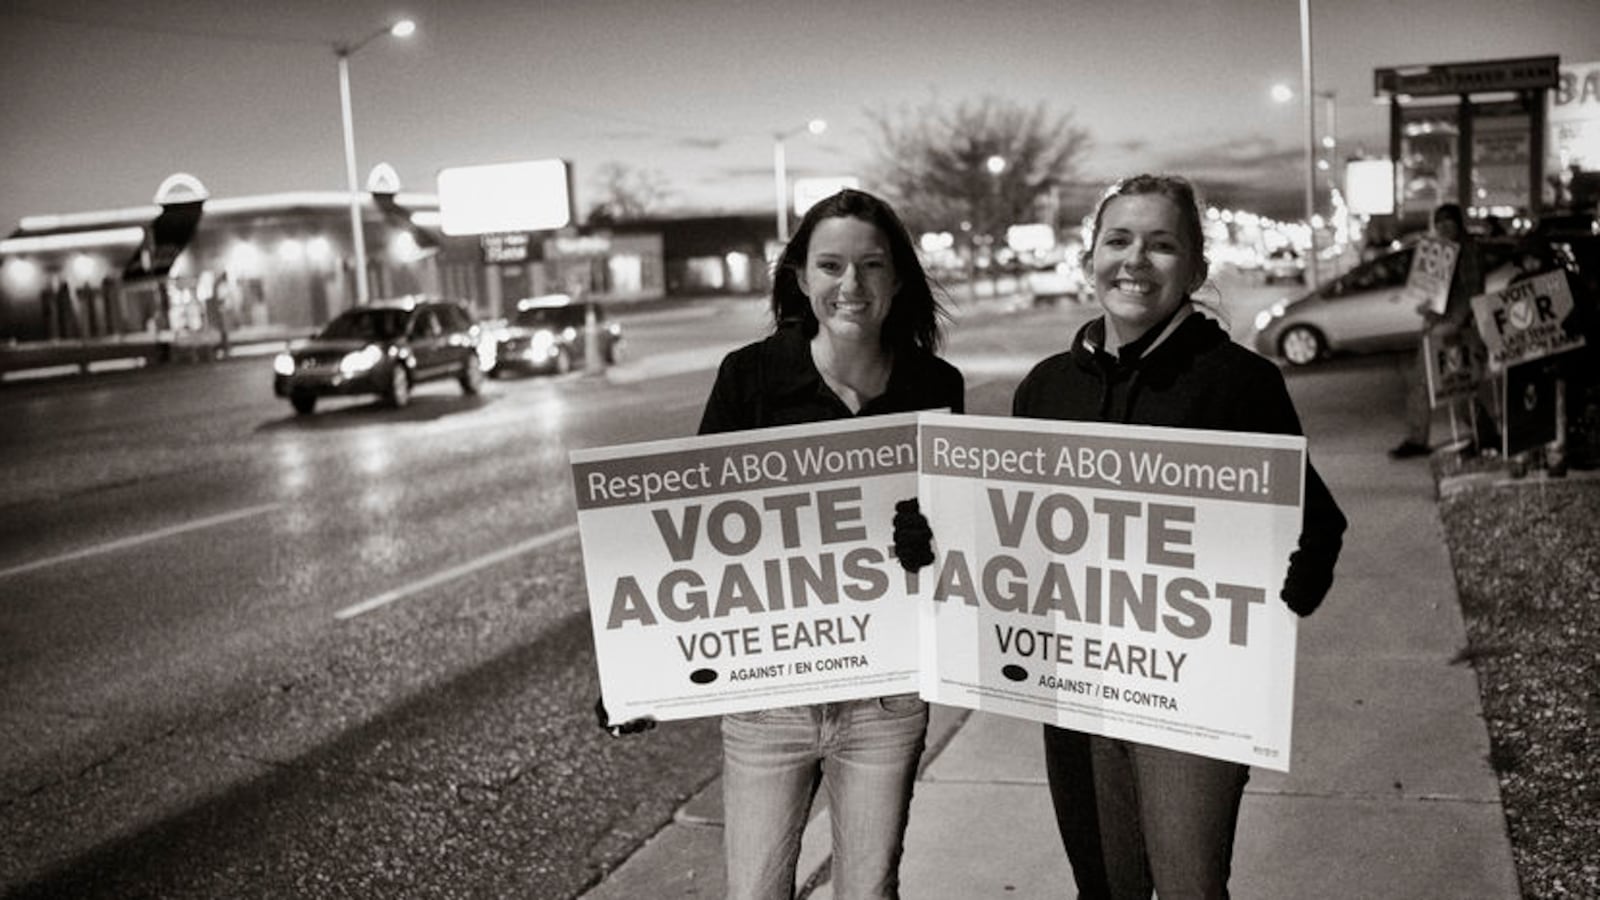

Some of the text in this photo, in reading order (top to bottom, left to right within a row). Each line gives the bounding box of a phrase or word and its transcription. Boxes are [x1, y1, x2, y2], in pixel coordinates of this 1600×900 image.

[588, 462, 711, 501] Respect
[720, 452, 788, 487] ABQ
[933, 437, 1271, 494] Respect ABQ Women!
[651, 486, 867, 562] VOTE
[987, 488, 1196, 569] VOTE
[933, 549, 1266, 647] AGAINST
[676, 613, 872, 662] VOTE EARLY
[995, 624, 1188, 683] VOTE EARLY
[729, 664, 785, 682] AGAINST
[795, 661, 813, 675] EN
[816, 654, 868, 673] CONTRA
[1038, 674, 1093, 697] AGAINST
[1102, 685, 1120, 701] EN
[1123, 688, 1178, 712] CONTRA
